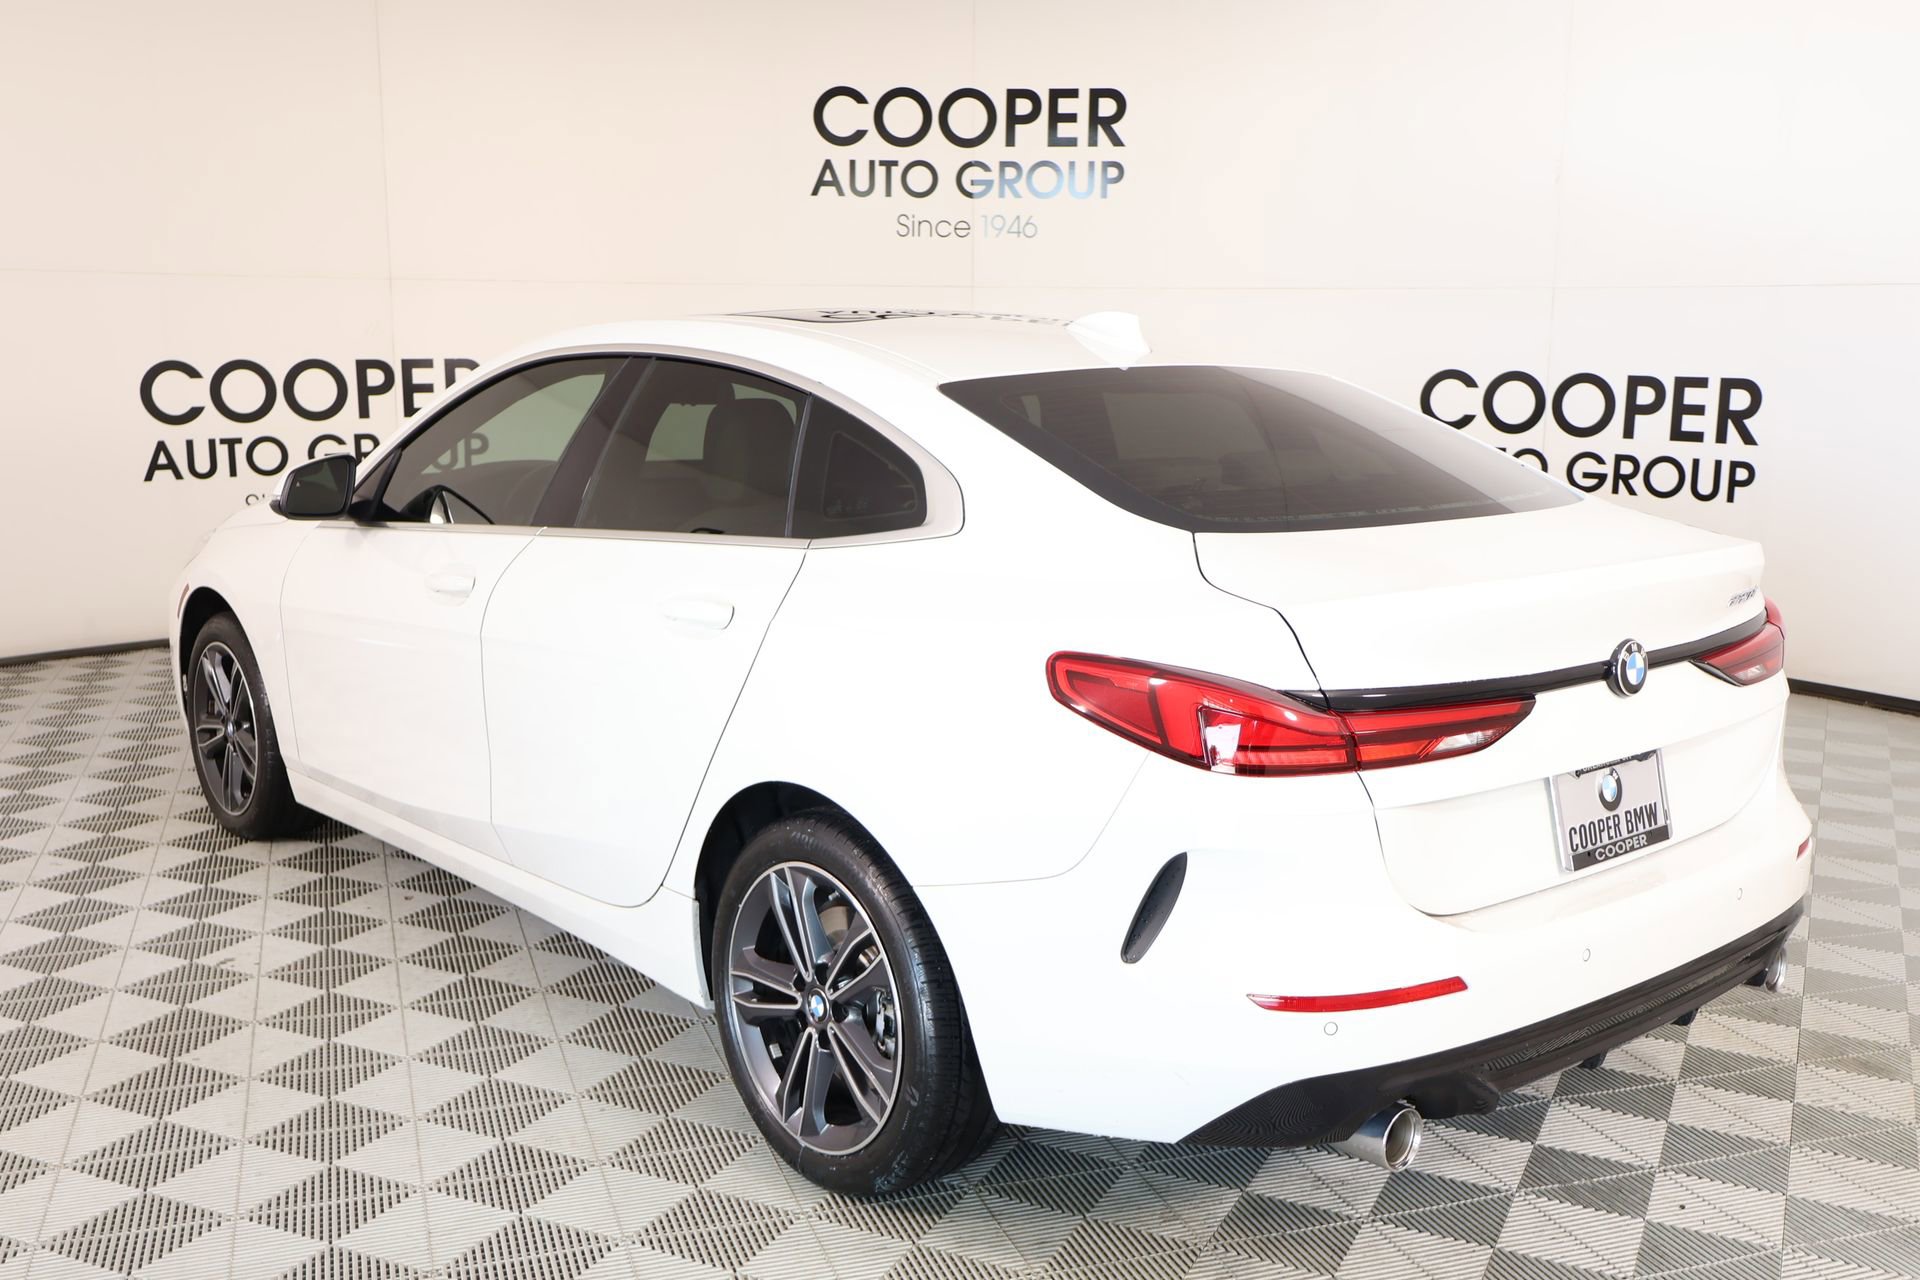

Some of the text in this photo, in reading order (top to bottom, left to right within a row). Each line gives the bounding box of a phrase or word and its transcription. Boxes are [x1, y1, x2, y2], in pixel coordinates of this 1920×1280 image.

[813, 85, 1127, 149] COOPER
[810, 158, 1125, 200] AUTO GROUP
[896, 213, 1038, 239] Since 1946
[1420, 368, 1763, 446] COOPER
[143, 435, 289, 482] AUTO
[1566, 451, 1756, 504] GROUP
[1568, 802, 1659, 853] COOPER BMW
[1595, 834, 1648, 861] COOPER
